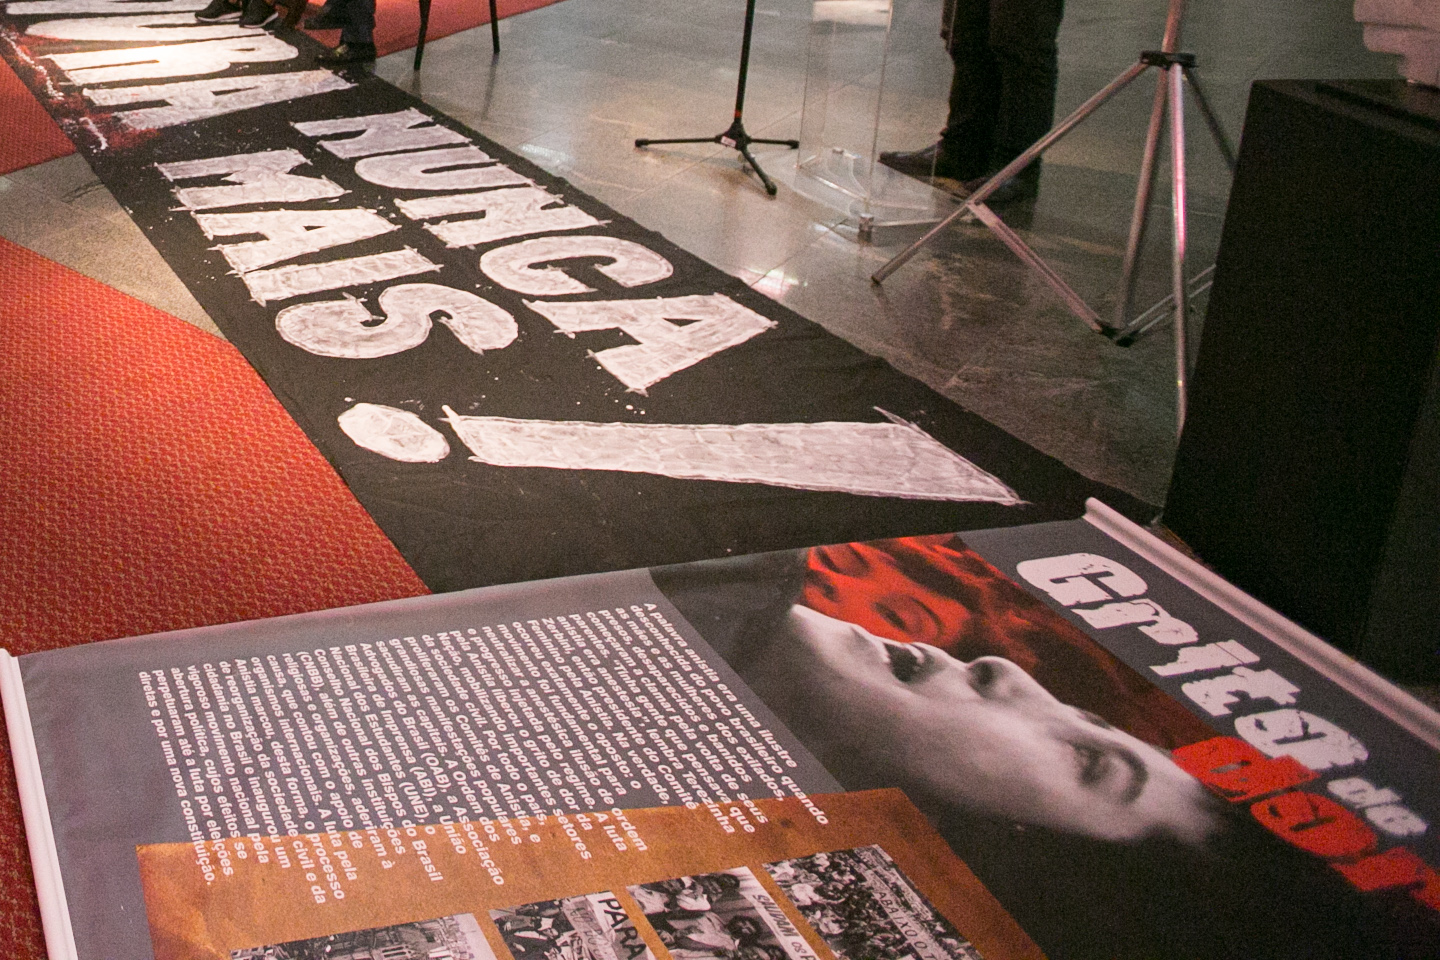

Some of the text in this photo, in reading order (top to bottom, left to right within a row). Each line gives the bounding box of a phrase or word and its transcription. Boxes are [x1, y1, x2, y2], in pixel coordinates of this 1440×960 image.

[154, 148, 519, 359] MAIS
[292, 107, 778, 395] NUNCA
[138, 671, 157, 707] diretas
[150, 718, 168, 737] por
[160, 740, 176, 765] uma
[169, 767, 187, 797] nova
[180, 799, 215, 885] constituição.
[151, 669, 185, 736] perpetuaram
[170, 667, 248, 859] abertura política, cujos efeitos se
[177, 738, 194, 755] até
[186, 664, 269, 863] vigoroso movimento nacional pela
[188, 767, 204, 792] luta
[202, 662, 229, 712] cidadania
[222, 714, 236, 729] no
[229, 730, 253, 764] Brasil
[247, 776, 281, 843] inaugurou
[274, 846, 291, 868] um
[234, 658, 256, 694] Anistia
[250, 695, 275, 739] marcou,
[270, 740, 291, 774] desta
[285, 776, 308, 818] forma,
[305, 832, 345, 899] processo
[250, 656, 284, 717] organismos
[277, 718, 331, 805] internacionais.
[281, 652, 312, 702] religiosas
[311, 712, 355, 794] organizações,
[350, 797, 387, 856] aderiram
[295, 651, 406, 854] (CNBB), além de outras instituições
[313, 648, 443, 881] Conselho Nacional dos Bispos do Brasil
[328, 646, 361, 689] Nacional
[352, 691, 370, 712] dos
[364, 713, 411, 778] Estudantes
[398, 781, 429, 822] (UNE),
[344, 644, 377, 692] Brasileira
[371, 693, 385, 707] de
[380, 709, 416, 763] Imprensa
[409, 766, 437, 801] (ABI),
[438, 814, 466, 854] União
[359, 642, 398, 698] Advogados
[392, 700, 407, 715] do
[401, 716, 430, 749] Brasil
[420, 752, 451, 792] (OAB),
[452, 806, 504, 885] Associação
[375, 640, 411, 692] sacudiram
[406, 694, 420, 707] as
[415, 709, 457, 756] capitais.
[452, 770, 484, 813] Ordem
[478, 816, 500, 842] dos
[388, 637, 522, 844] grandiosas manifestações populares
[436, 631, 592, 859] Nação, mobilizando importantes setores
[481, 625, 524, 677] neutralizar
[525, 688, 573, 747] anestésica
[568, 748, 600, 785] ilusão
[597, 788, 614, 804] de
[610, 807, 648, 851] ordem
[496, 623, 627, 795] movimento foi fundamental para
[511, 621, 545, 659] ocorreu
[540, 660, 590, 720] exatamente
[594, 732, 633, 777] oposto:
[526, 619, 670, 804] Feminino pela Anistia. Na verdade,
[540, 617, 699, 809] Zerbini, então presidente do Comitê
[556, 615, 586, 647] anistia
[582, 648, 601, 665] era
[645, 728, 684, 769] lembra
[681, 770, 735, 833] Terezinha
[568, 613, 610, 658] parentes.
[634, 695, 670, 726] gente
[664, 728, 688, 750] que
[681, 753, 732, 804] pensava
[729, 806, 755, 833] que
[597, 609, 632, 644] presos,
[631, 646, 701, 722] desaparecidos
[705, 733, 752, 782] banidos
[629, 604, 829, 824] desconhecida do povo brasileiro quando
[649, 611, 688, 647] palavra
[684, 648, 719, 681] anistia
[716, 683, 737, 701] era
[734, 703, 761, 727] uma
[757, 729, 797, 767] ilustre
[1016, 552, 1430, 837] Grito de
[194, 795, 213, 817] por
[206, 819, 234, 876] eleições
[323, 820, 342, 847] luta
[332, 850, 357, 880] pela
[598, 898, 647, 960] PARA
[752, 894, 800, 937] SAUDAM
[877, 891, 918, 937] ABAIXO
